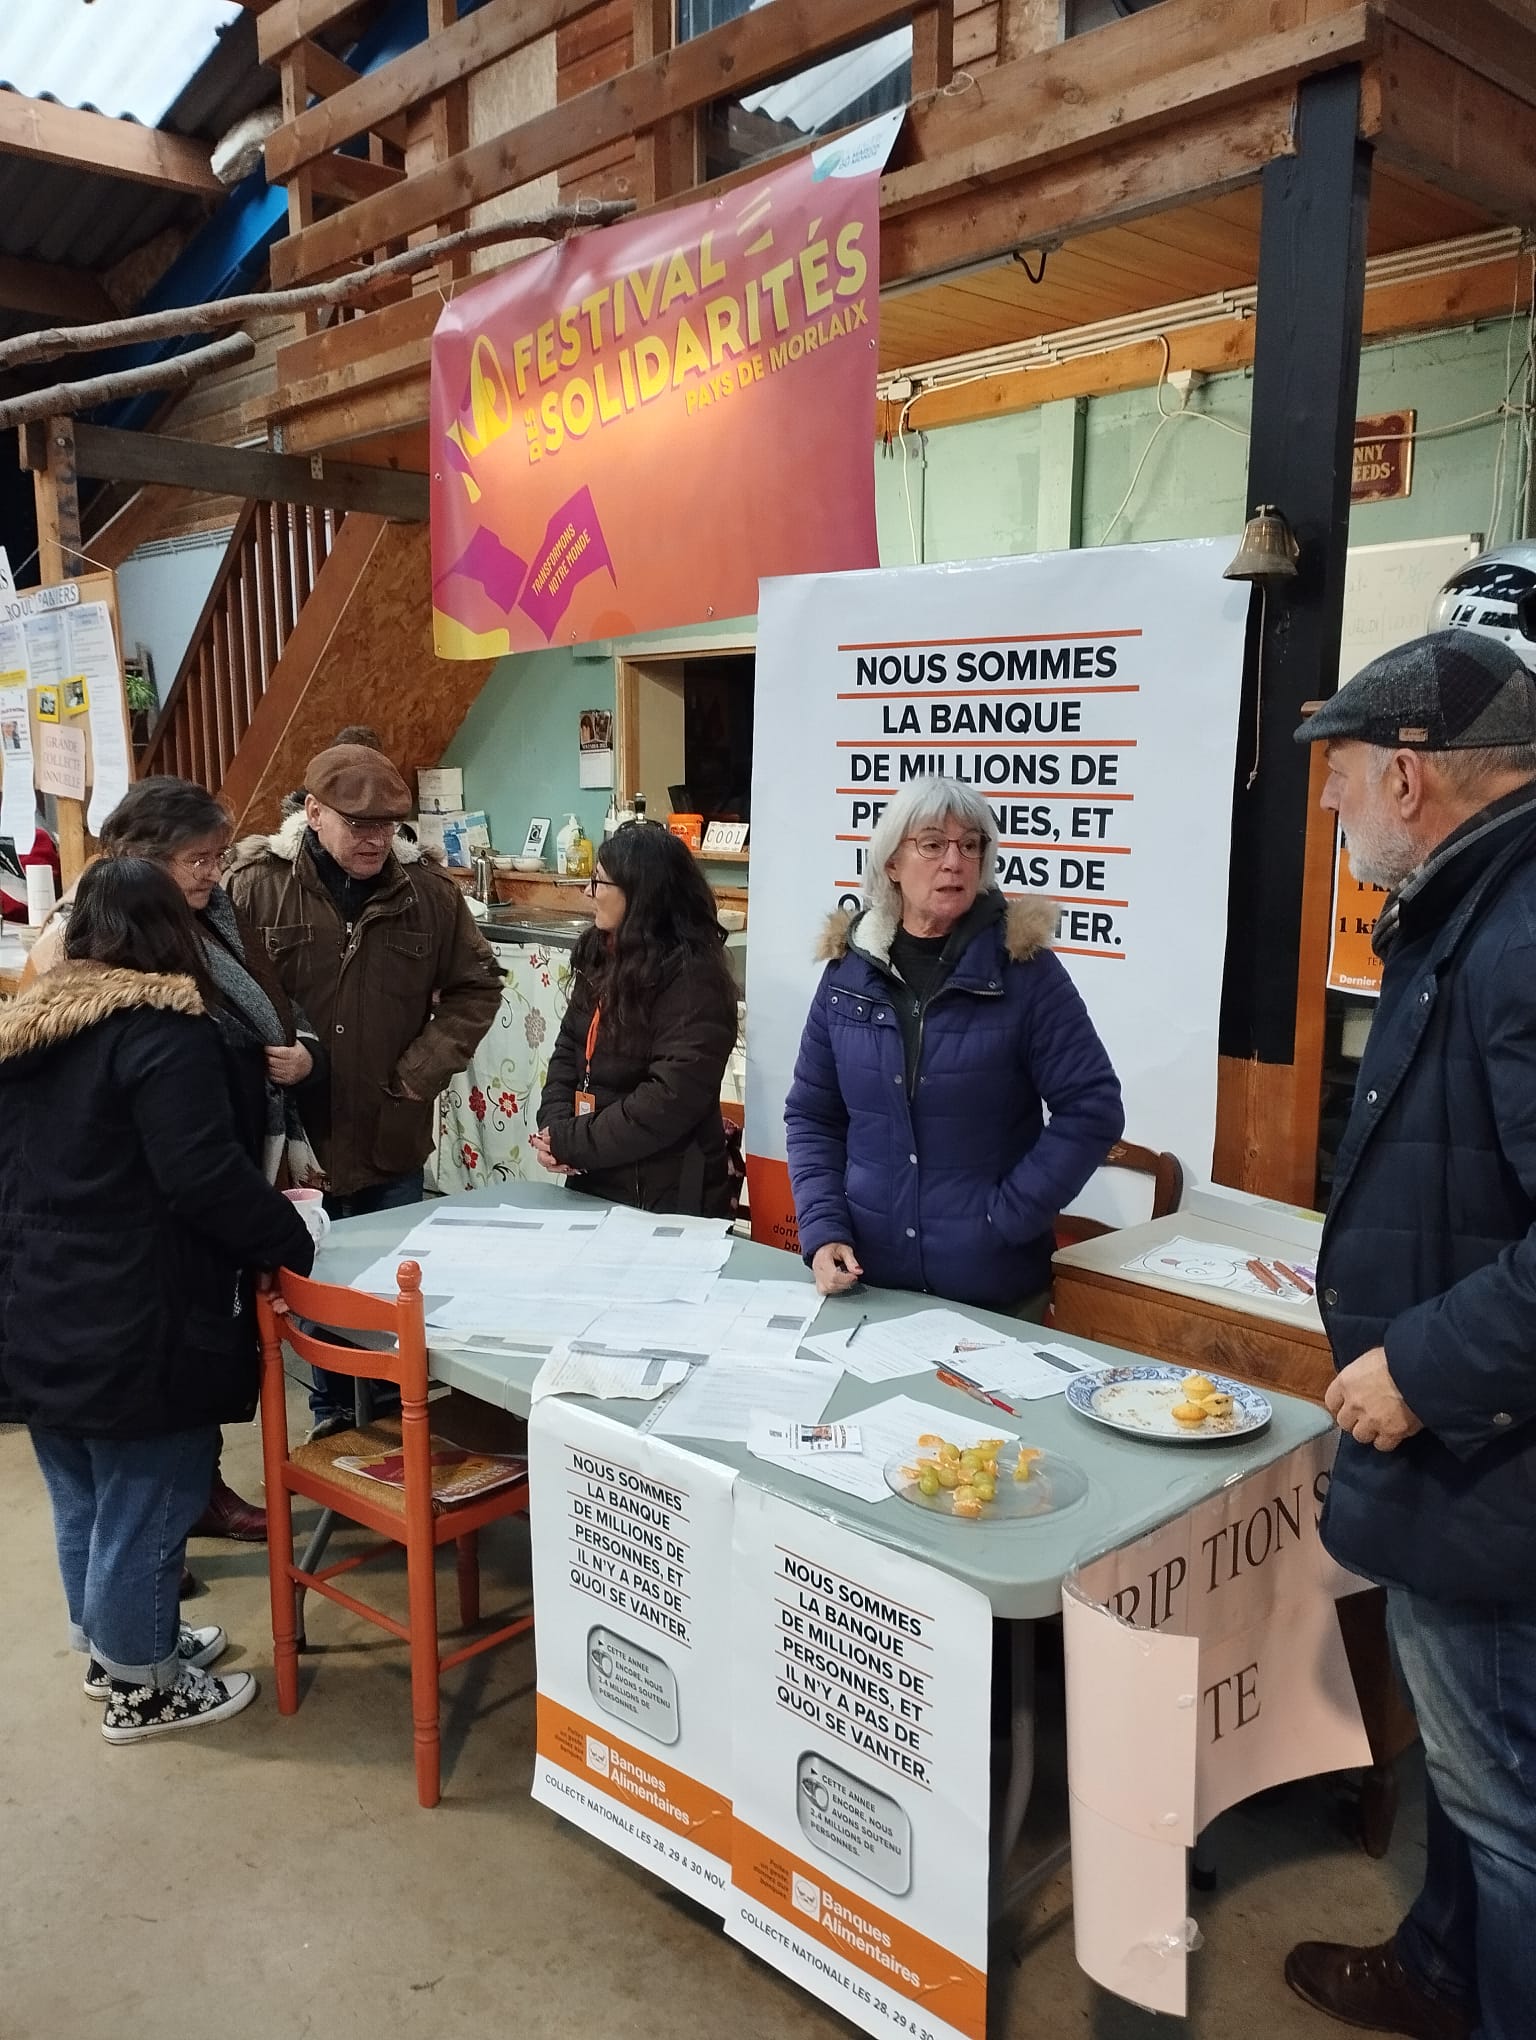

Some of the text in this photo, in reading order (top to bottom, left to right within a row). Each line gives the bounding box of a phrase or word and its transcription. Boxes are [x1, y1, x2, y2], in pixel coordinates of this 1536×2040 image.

[513, 230, 726, 398] FESTIVAL
[541, 216, 867, 453] SOLIDARITÉS
[685, 300, 869, 415] PAYS DE MORLAIX
[523, 407, 543, 464] DES
[1354, 444, 1386, 463] NNY
[1354, 463, 1391, 481] EEDS
[532, 522, 576, 597] TRANSFORMONS
[548, 528, 591, 597] NOTRE MONDE
[857, 646, 1117, 685] NOUS SOMMES
[883, 702, 1081, 734] LA BANQUE
[851, 754, 1118, 785] DE MILLIONS DE
[706, 829, 742, 845] COOL
[1072, 807, 1113, 838] ET
[1060, 858, 1105, 890] DE
[1055, 909, 1122, 945] TER.
[1339, 917, 1347, 933] 1
[1339, 974, 1377, 987] Dernier
[573, 1453, 682, 1511] NOUS SOMMES
[588, 1482, 670, 1531] LA BANQUE
[574, 1499, 684, 1564] DE MILLIONS DE
[575, 1524, 684, 1587] PERSONNES, ET
[570, 1568, 690, 1642] QUOI SE VANTER.
[578, 1547, 682, 1613] IL N'Y A PAS DE
[784, 1557, 922, 1637] NOUS SOMMES
[782, 1609, 924, 1696] DE MILLIONS DE
[799, 1591, 904, 1657] LA BANQUE
[609, 1682, 640, 1704] MILLIONS
[641, 1700, 651, 1710] DE
[615, 1673, 671, 1709] AVONS SOUTENU
[644, 1677, 664, 1694] NOUS
[783, 1636, 923, 1722] PERSONNES, ET
[786, 1663, 920, 1750] IL N'Y A PAS DE
[1203, 1662, 1262, 1744] TE
[777, 1685, 930, 1785] QUOI SE VANTER.
[610, 1748, 666, 1793] Banques
[610, 1768, 690, 1826] Alimentaires
[821, 1775, 847, 1795] CETTE
[545, 1774, 727, 1891] COLLECTE NATIONALE LES 28, 29 & 30 NOV.
[810, 1820, 860, 1856] PERSONNES.
[824, 1816, 861, 1845] MILLIONS
[863, 1840, 875, 1853] DE
[832, 1808, 902, 1855] AVONS SOUTENU
[868, 1816, 893, 1837] NOUS
[822, 1889, 892, 1948] Banques
[740, 1908, 790, 1948] COLLECTE
[791, 1941, 850, 1989] NATIONALE
[852, 1983, 871, 2003] LES
[873, 1998, 890, 2018] 28,
[892, 2010, 908, 2028] 29
[909, 2022, 916, 2035] &
[821, 1911, 921, 1988] Alimentaires
